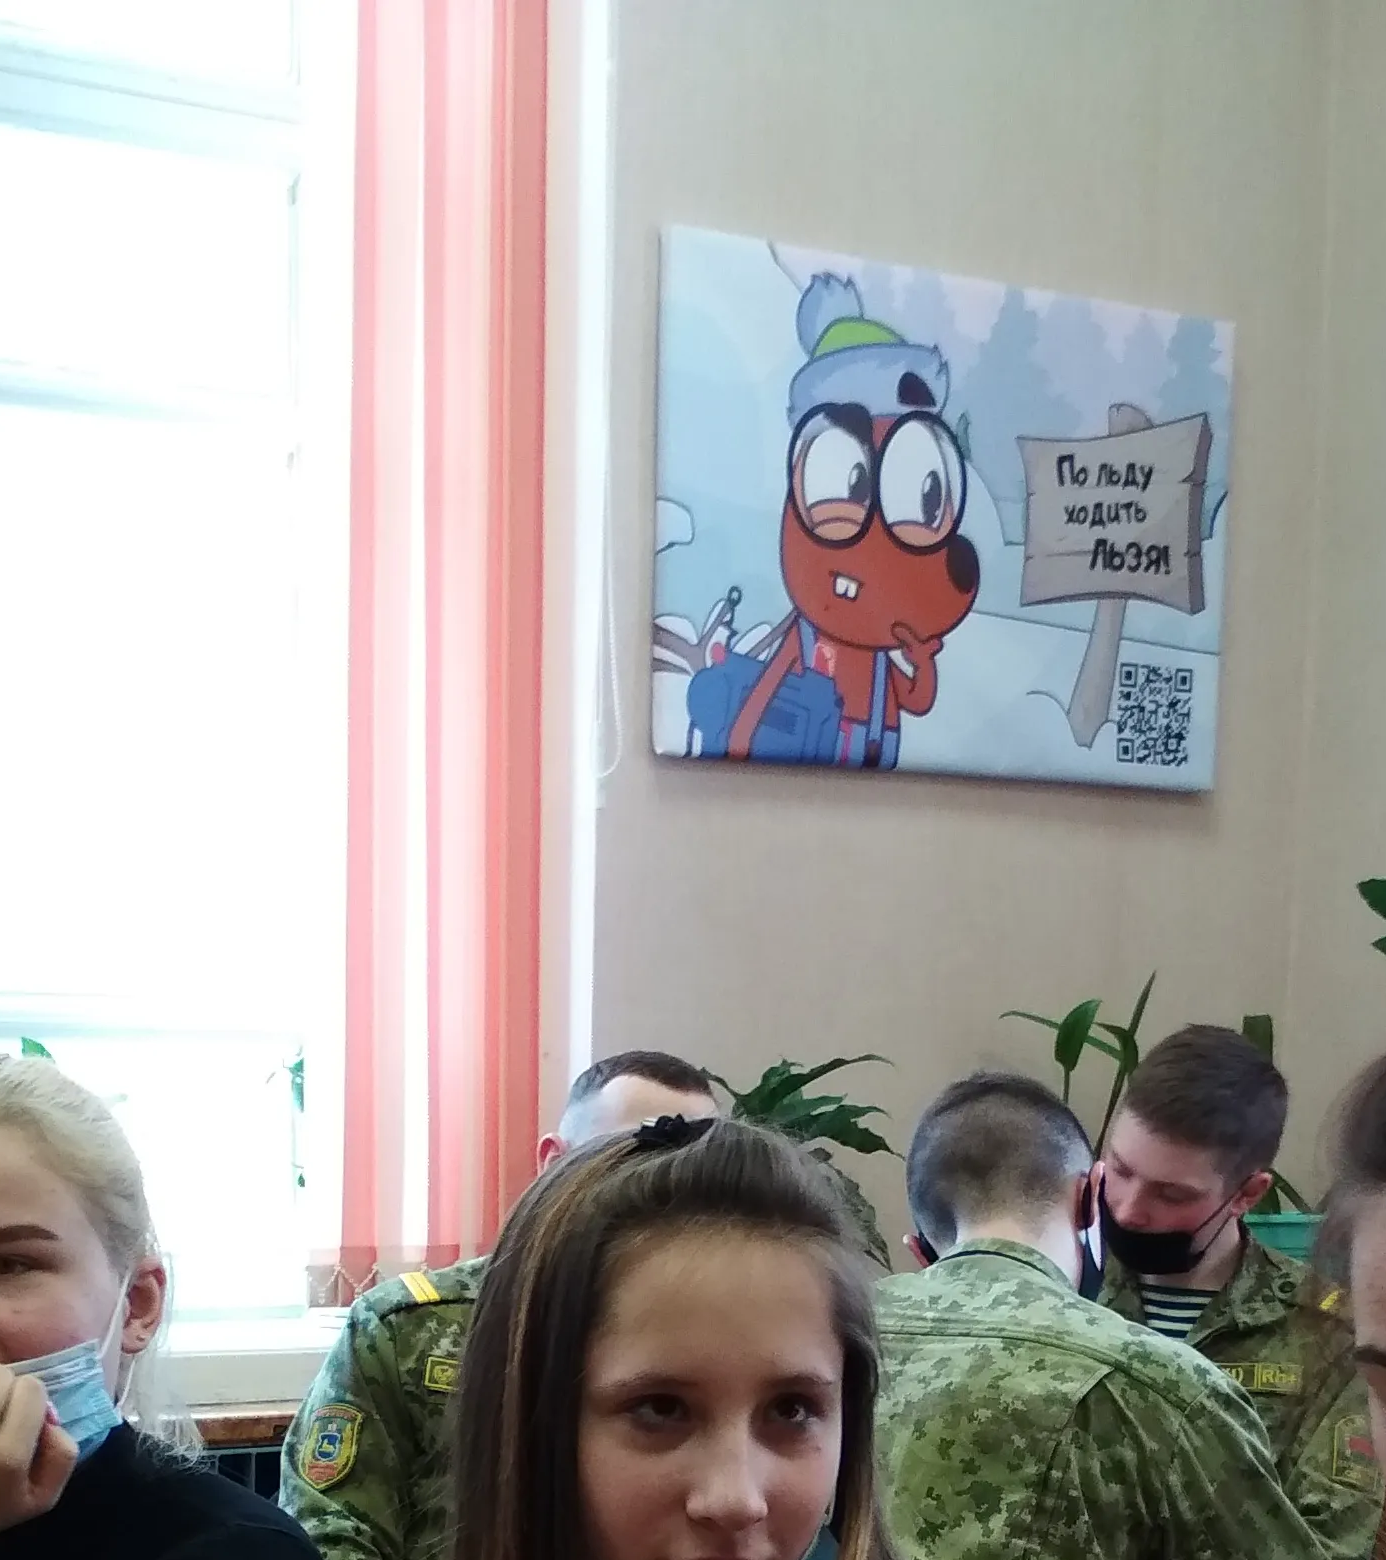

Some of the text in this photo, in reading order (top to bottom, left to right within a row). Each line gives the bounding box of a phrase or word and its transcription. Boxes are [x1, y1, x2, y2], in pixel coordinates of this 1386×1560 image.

[1055, 453, 1156, 493] По льду
[1063, 499, 1148, 530] ходить
[1088, 537, 1173, 576] ЛЬЗЯ!
